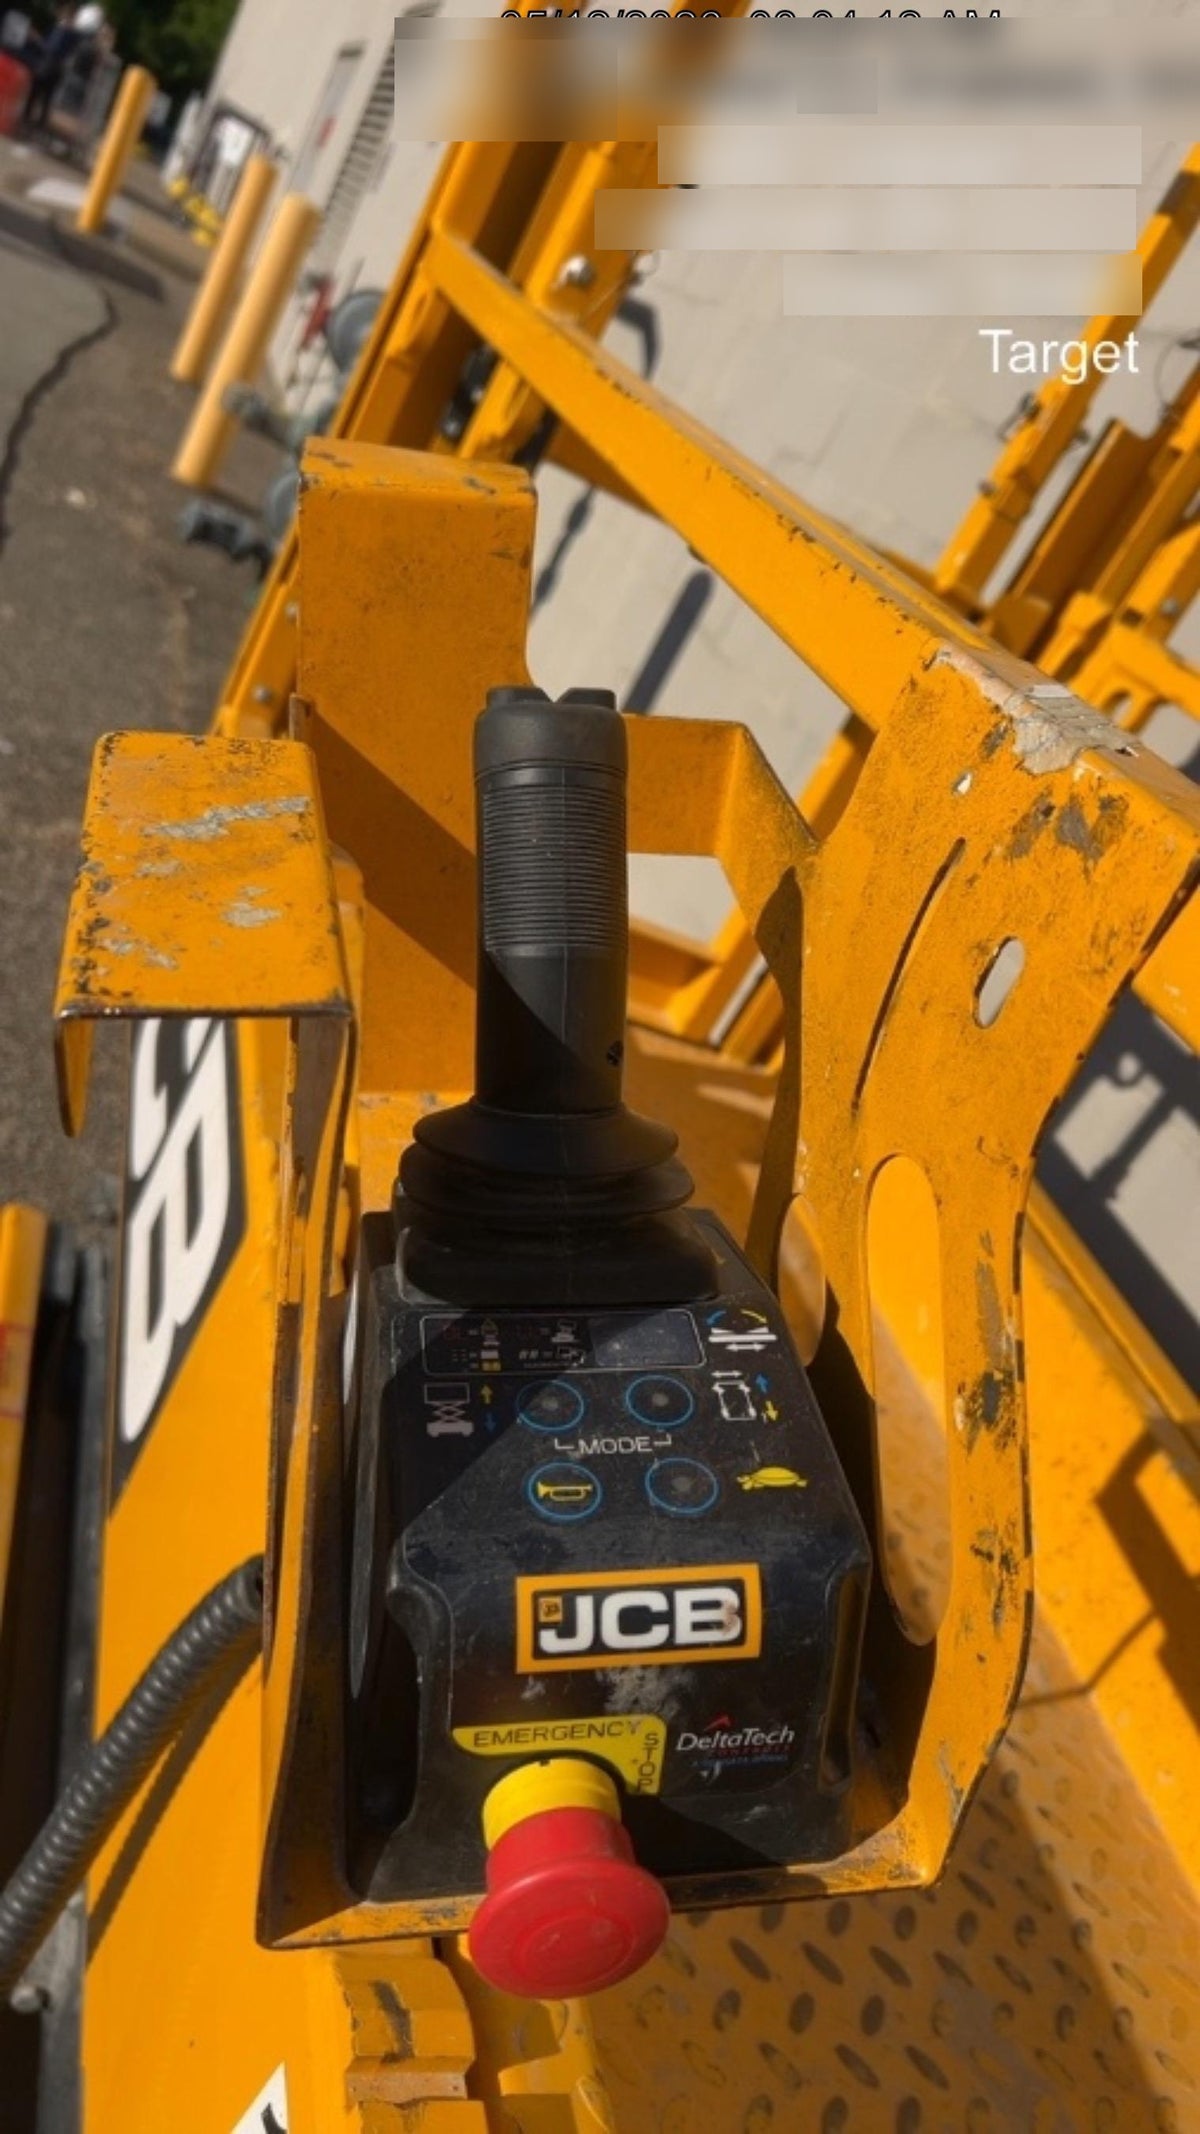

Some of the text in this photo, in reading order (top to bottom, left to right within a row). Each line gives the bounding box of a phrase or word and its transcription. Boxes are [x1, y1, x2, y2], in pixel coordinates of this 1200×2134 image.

[577, 1435, 654, 1456] MODE
[538, 1586, 743, 1654] JCB
[472, 1721, 642, 1747] EMERGENCY
[675, 1724, 796, 1752] DeltaTech
[636, 1732, 661, 1794] STOP
